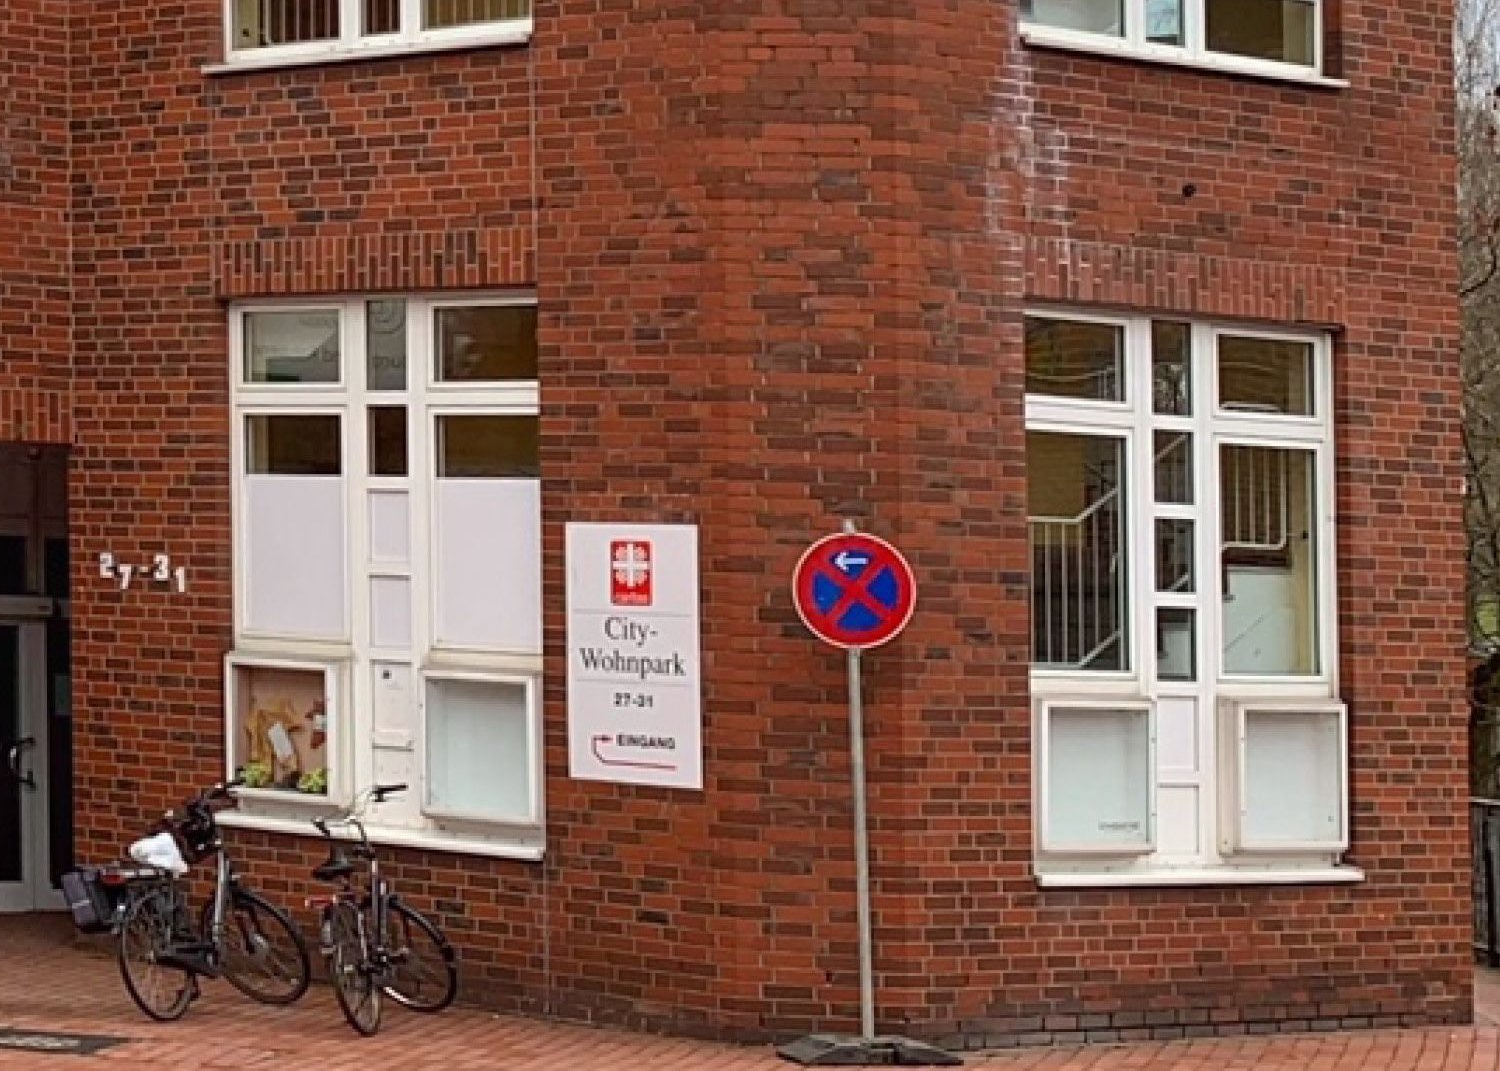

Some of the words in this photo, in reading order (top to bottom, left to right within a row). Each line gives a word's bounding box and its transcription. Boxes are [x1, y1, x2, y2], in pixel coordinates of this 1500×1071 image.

[99, 552, 186, 593] 27-31
[604, 615, 659, 648] City-
[579, 647, 687, 680] Wohnpark
[613, 692, 654, 708] 27-31
[616, 733, 677, 750] EINGANG
